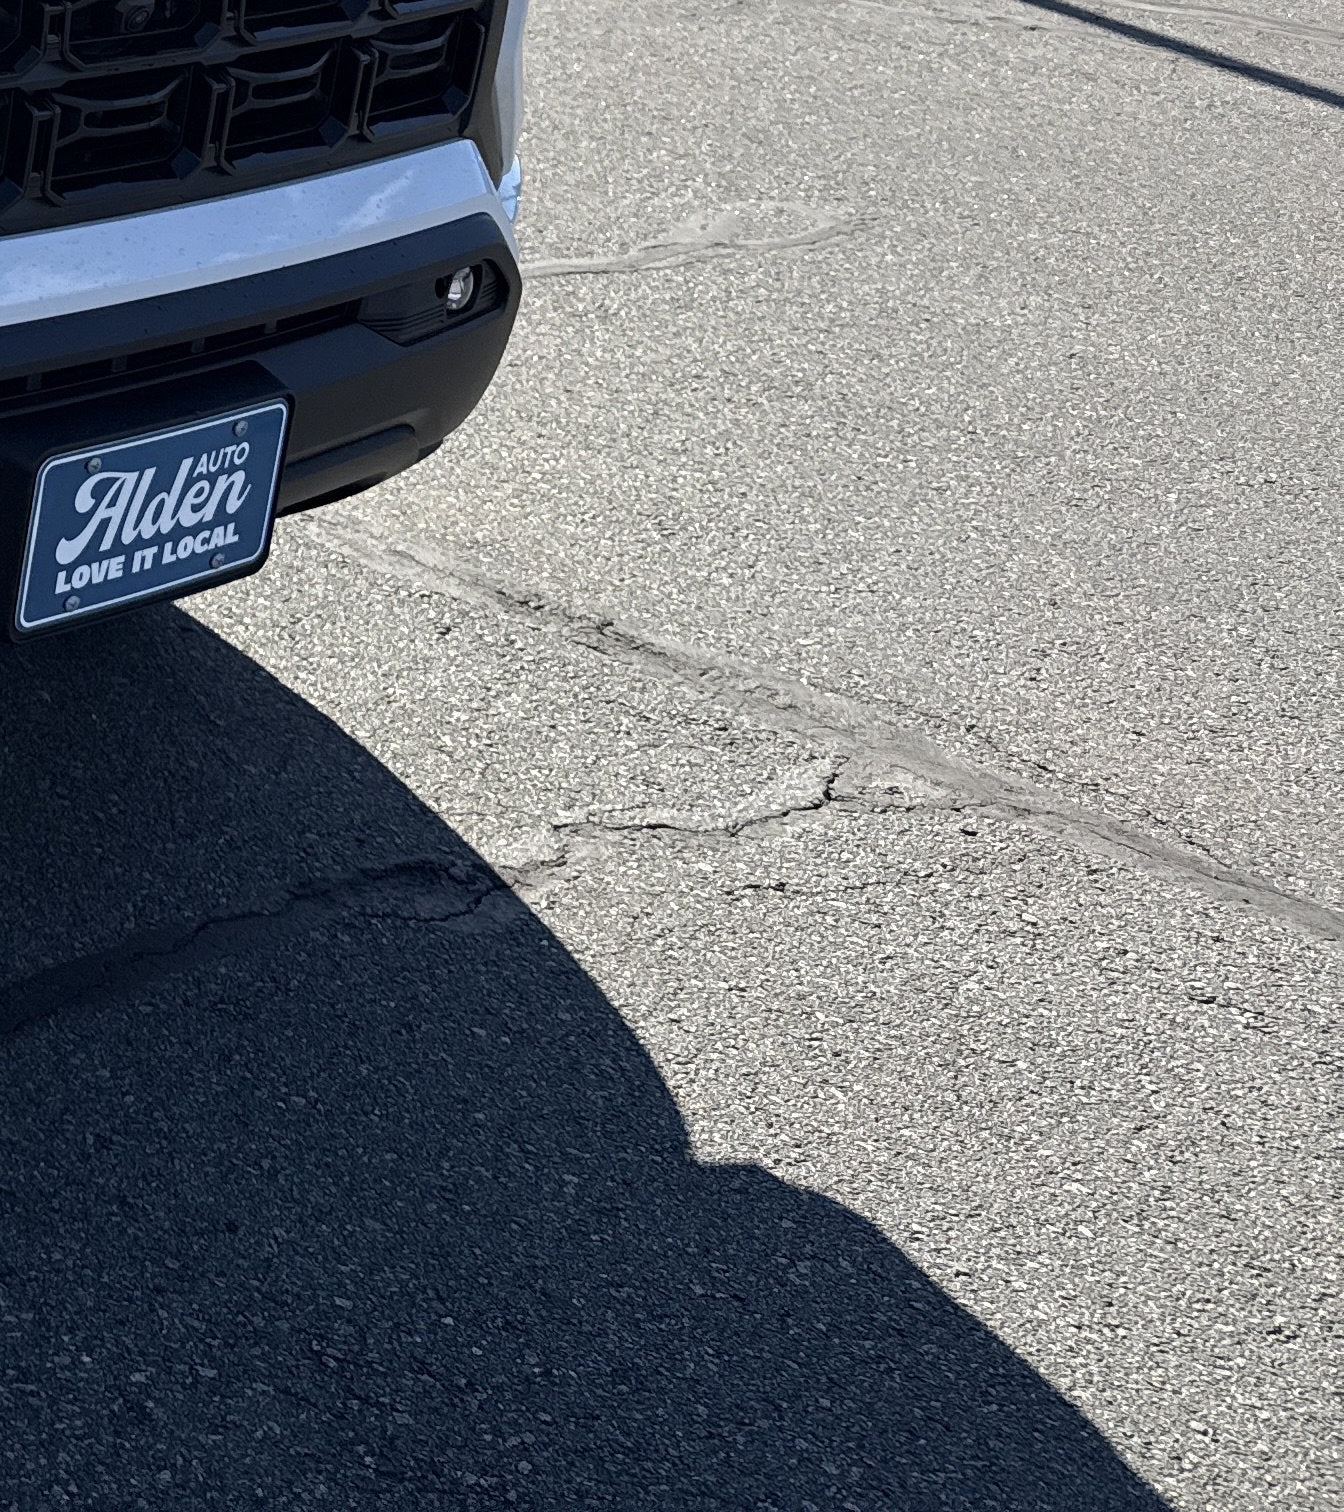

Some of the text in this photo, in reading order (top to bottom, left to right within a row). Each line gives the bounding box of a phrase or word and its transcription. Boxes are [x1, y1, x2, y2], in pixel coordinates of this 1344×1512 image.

[193, 441, 250, 478] AUTO
[55, 456, 252, 565] Alden
[55, 522, 239, 594] LOVE IT LOCAL
